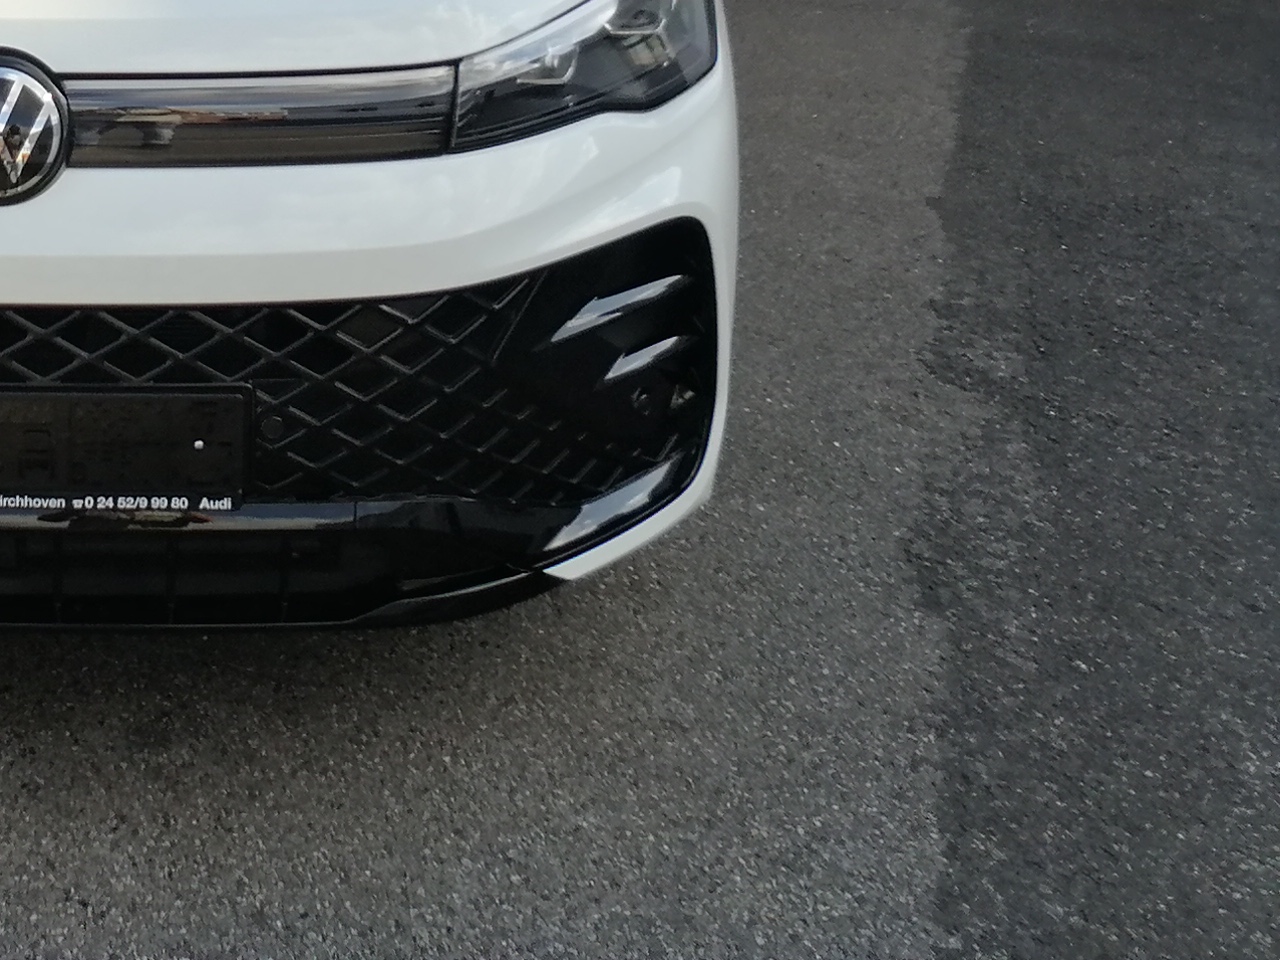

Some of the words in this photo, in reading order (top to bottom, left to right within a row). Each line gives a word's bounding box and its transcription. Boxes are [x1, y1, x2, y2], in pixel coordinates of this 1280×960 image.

[96, 495, 114, 509] 24
[150, 496, 168, 510] 99
[171, 496, 189, 510] 80
[199, 496, 232, 510] Audi
